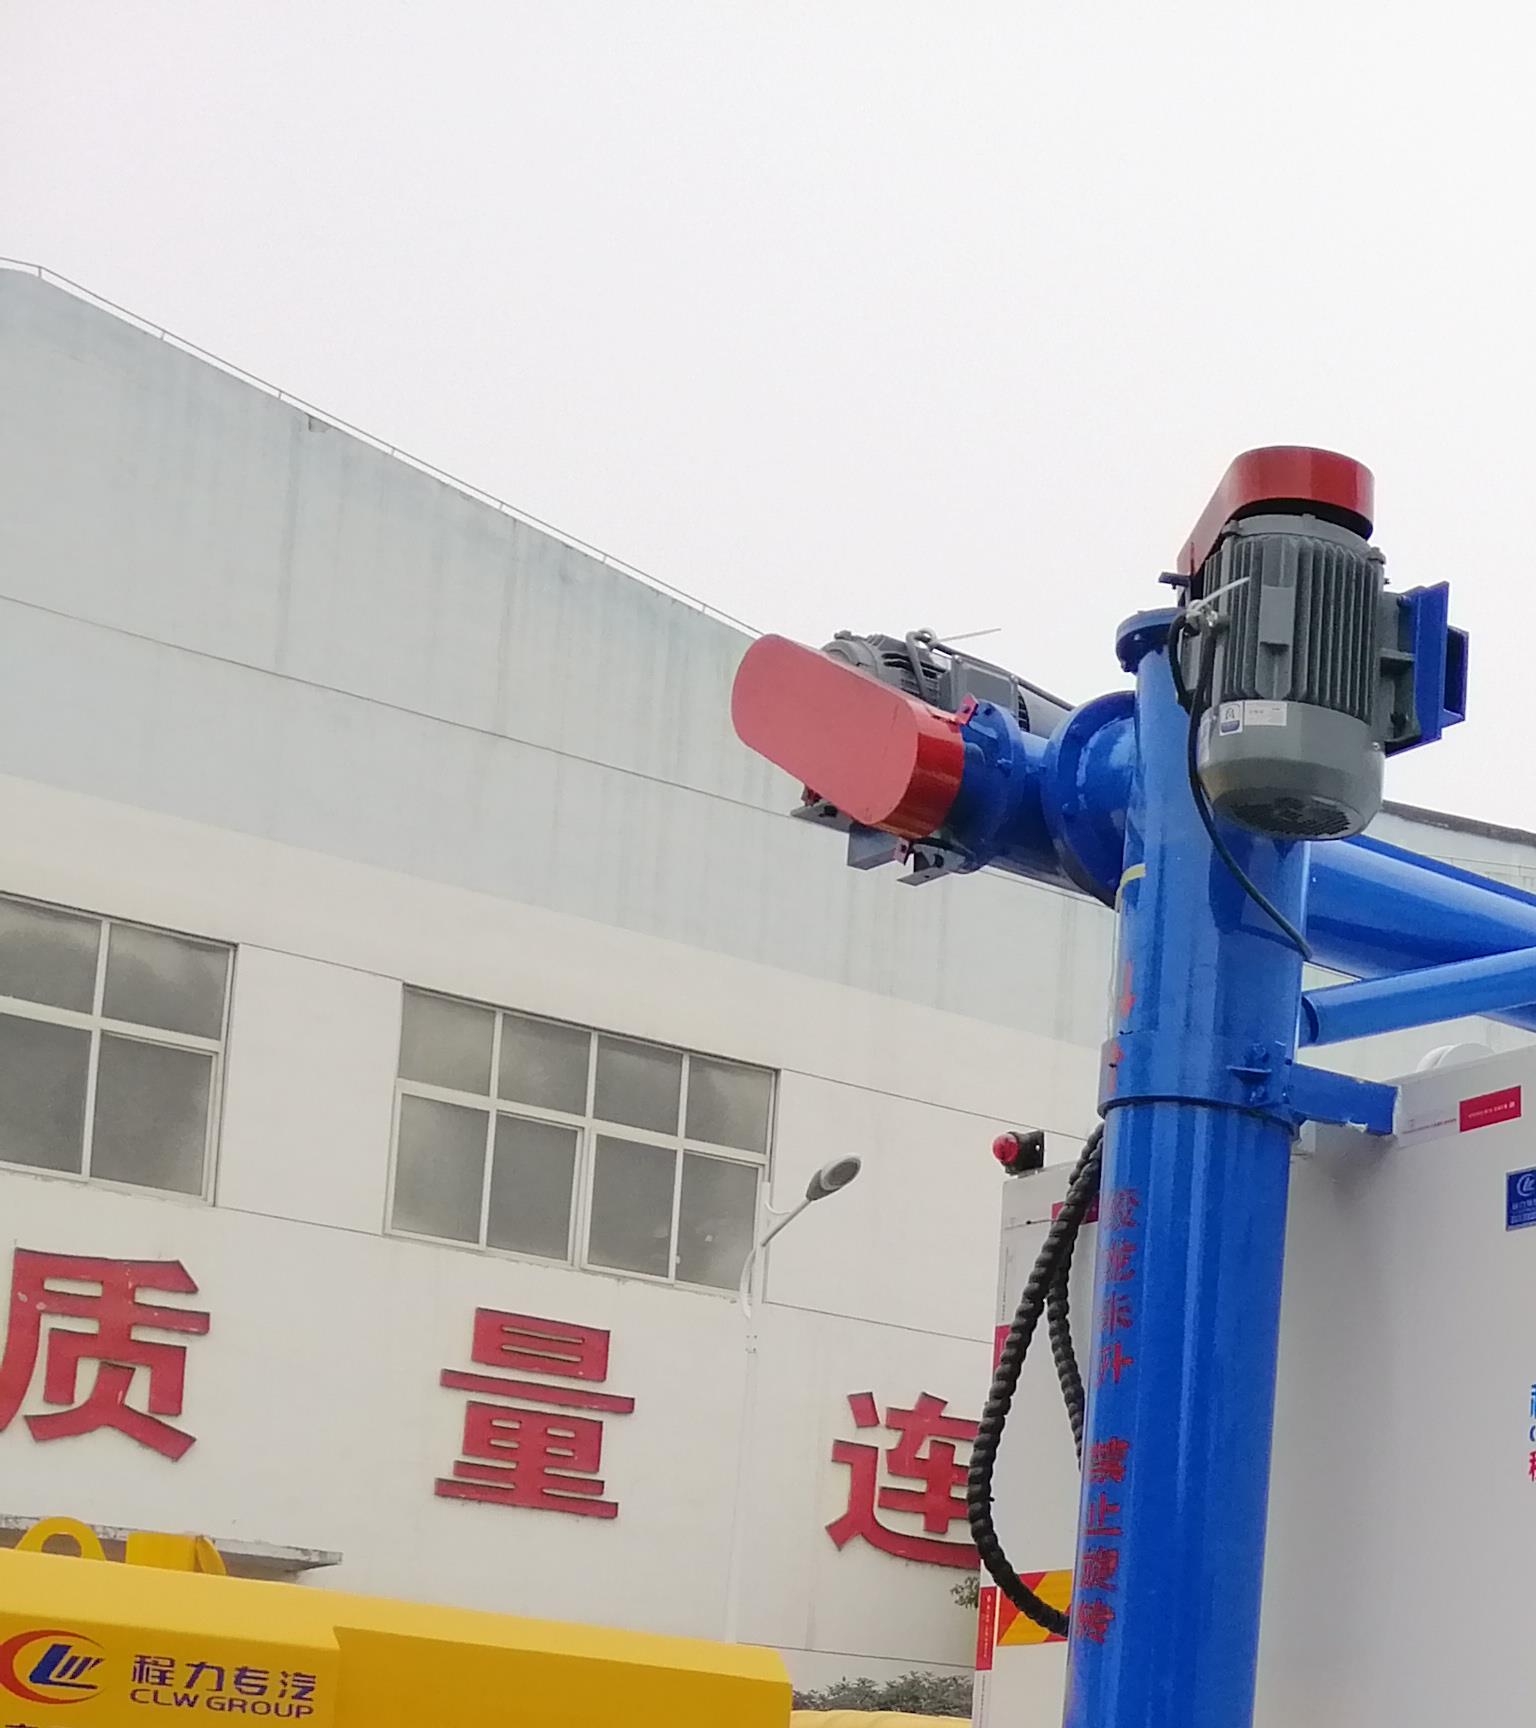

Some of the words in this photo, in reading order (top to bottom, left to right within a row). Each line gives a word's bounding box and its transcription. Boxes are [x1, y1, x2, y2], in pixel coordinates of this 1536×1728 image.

[131, 1654, 317, 1702] 程力专汽
[130, 1688, 199, 1708] CLW
[206, 1696, 314, 1719] GROUP
